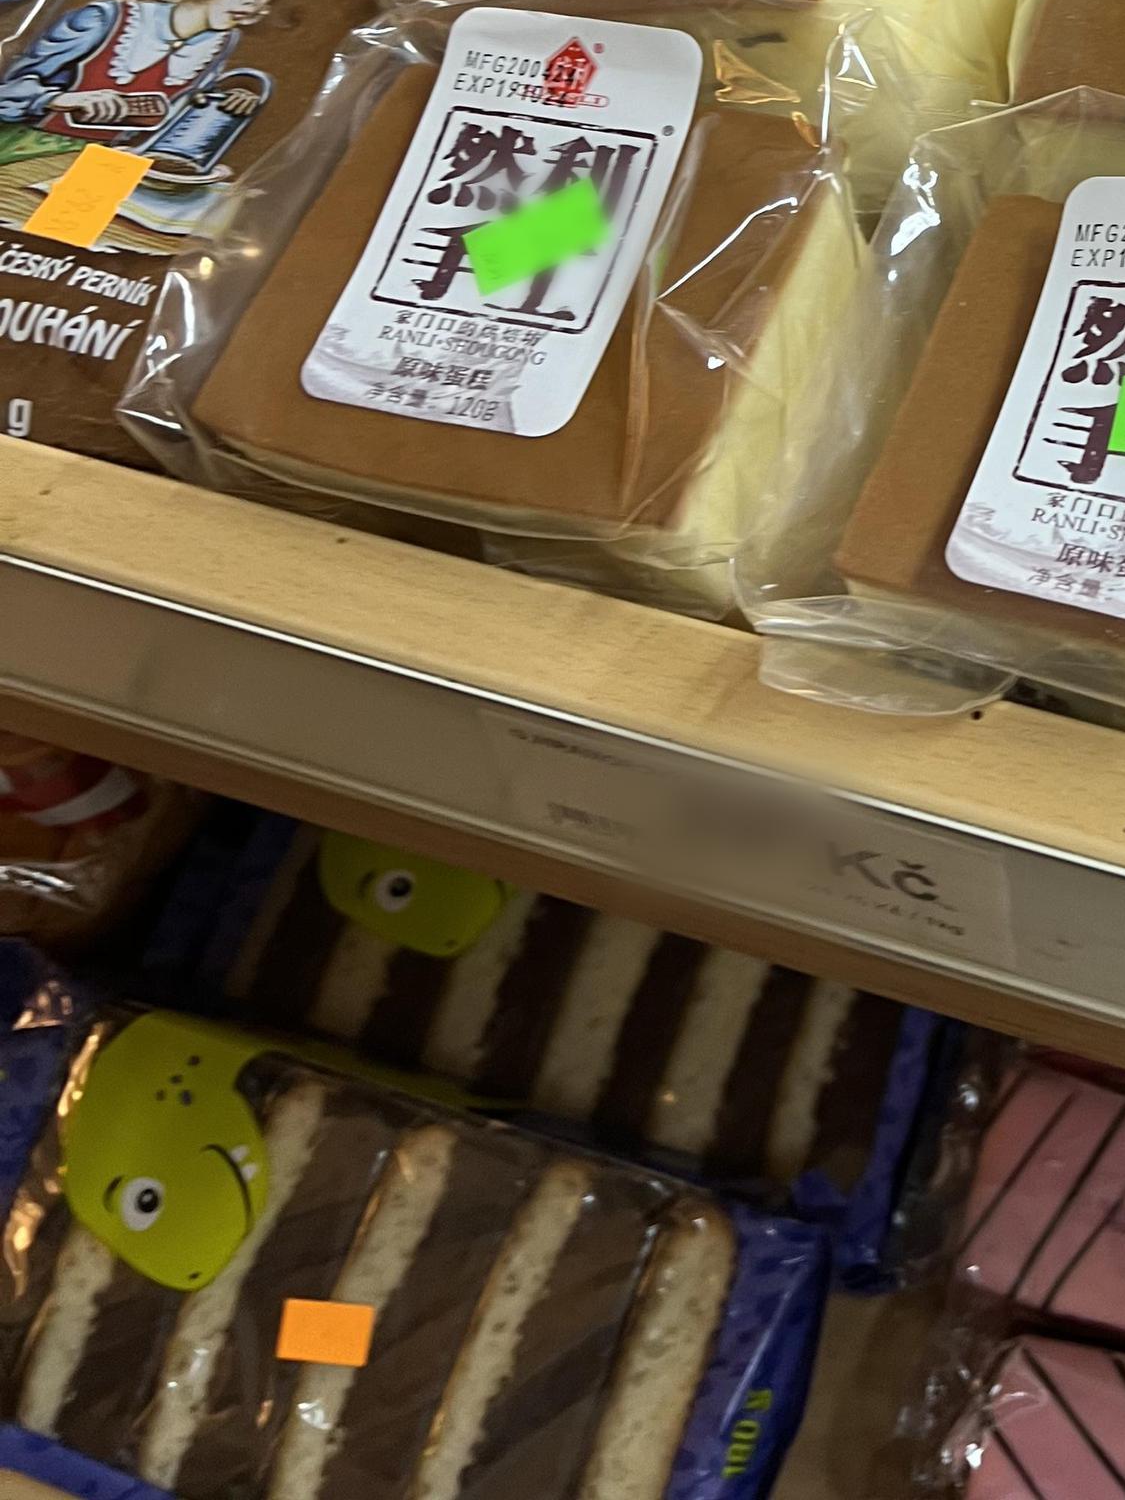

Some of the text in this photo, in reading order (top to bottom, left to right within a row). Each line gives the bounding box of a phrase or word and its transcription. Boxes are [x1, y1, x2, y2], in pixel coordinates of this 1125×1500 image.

[427, 121, 642, 222] 然利
[66, 266, 157, 307] PERNÍK
[828, 841, 940, 902] Kč
